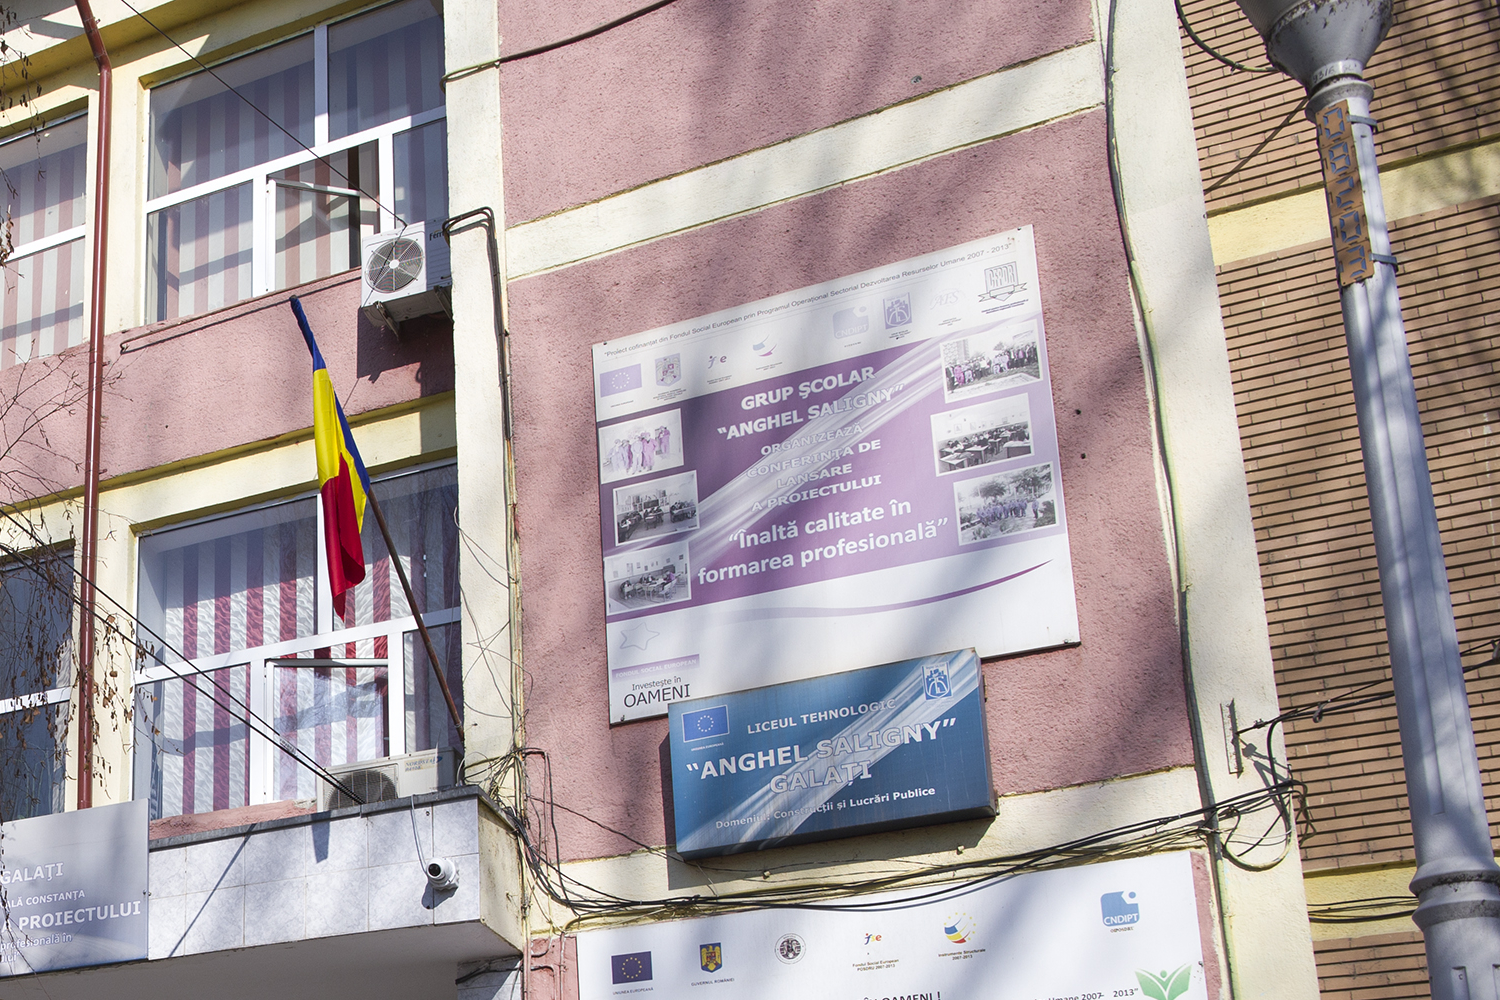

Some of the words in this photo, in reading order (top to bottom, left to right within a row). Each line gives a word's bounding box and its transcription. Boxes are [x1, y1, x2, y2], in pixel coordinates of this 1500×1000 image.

[740, 385, 793, 411] GRUP
[760, 420, 862, 457] ORGANIZEAZĂ
[858, 438, 881, 453] DE
[776, 462, 852, 489] LANSARE
[751, 500, 762, 512] A
[766, 473, 881, 508] PROIECTULUI
[804, 503, 884, 535] calitate
[889, 498, 911, 517] în
[697, 551, 794, 585] formarea
[623, 683, 690, 708] OAMENI
[747, 715, 797, 734] LICEUL
[800, 697, 895, 725] TEHNOLOGIC
[715, 812, 770, 830] Domeniul:
[849, 792, 890, 808] Lucrări
[892, 785, 935, 801] Publice
[18, 900, 141, 931] PROIECTULUI
[1103, 912, 1139, 926] CNDIPT
[61, 932, 72, 942] în
